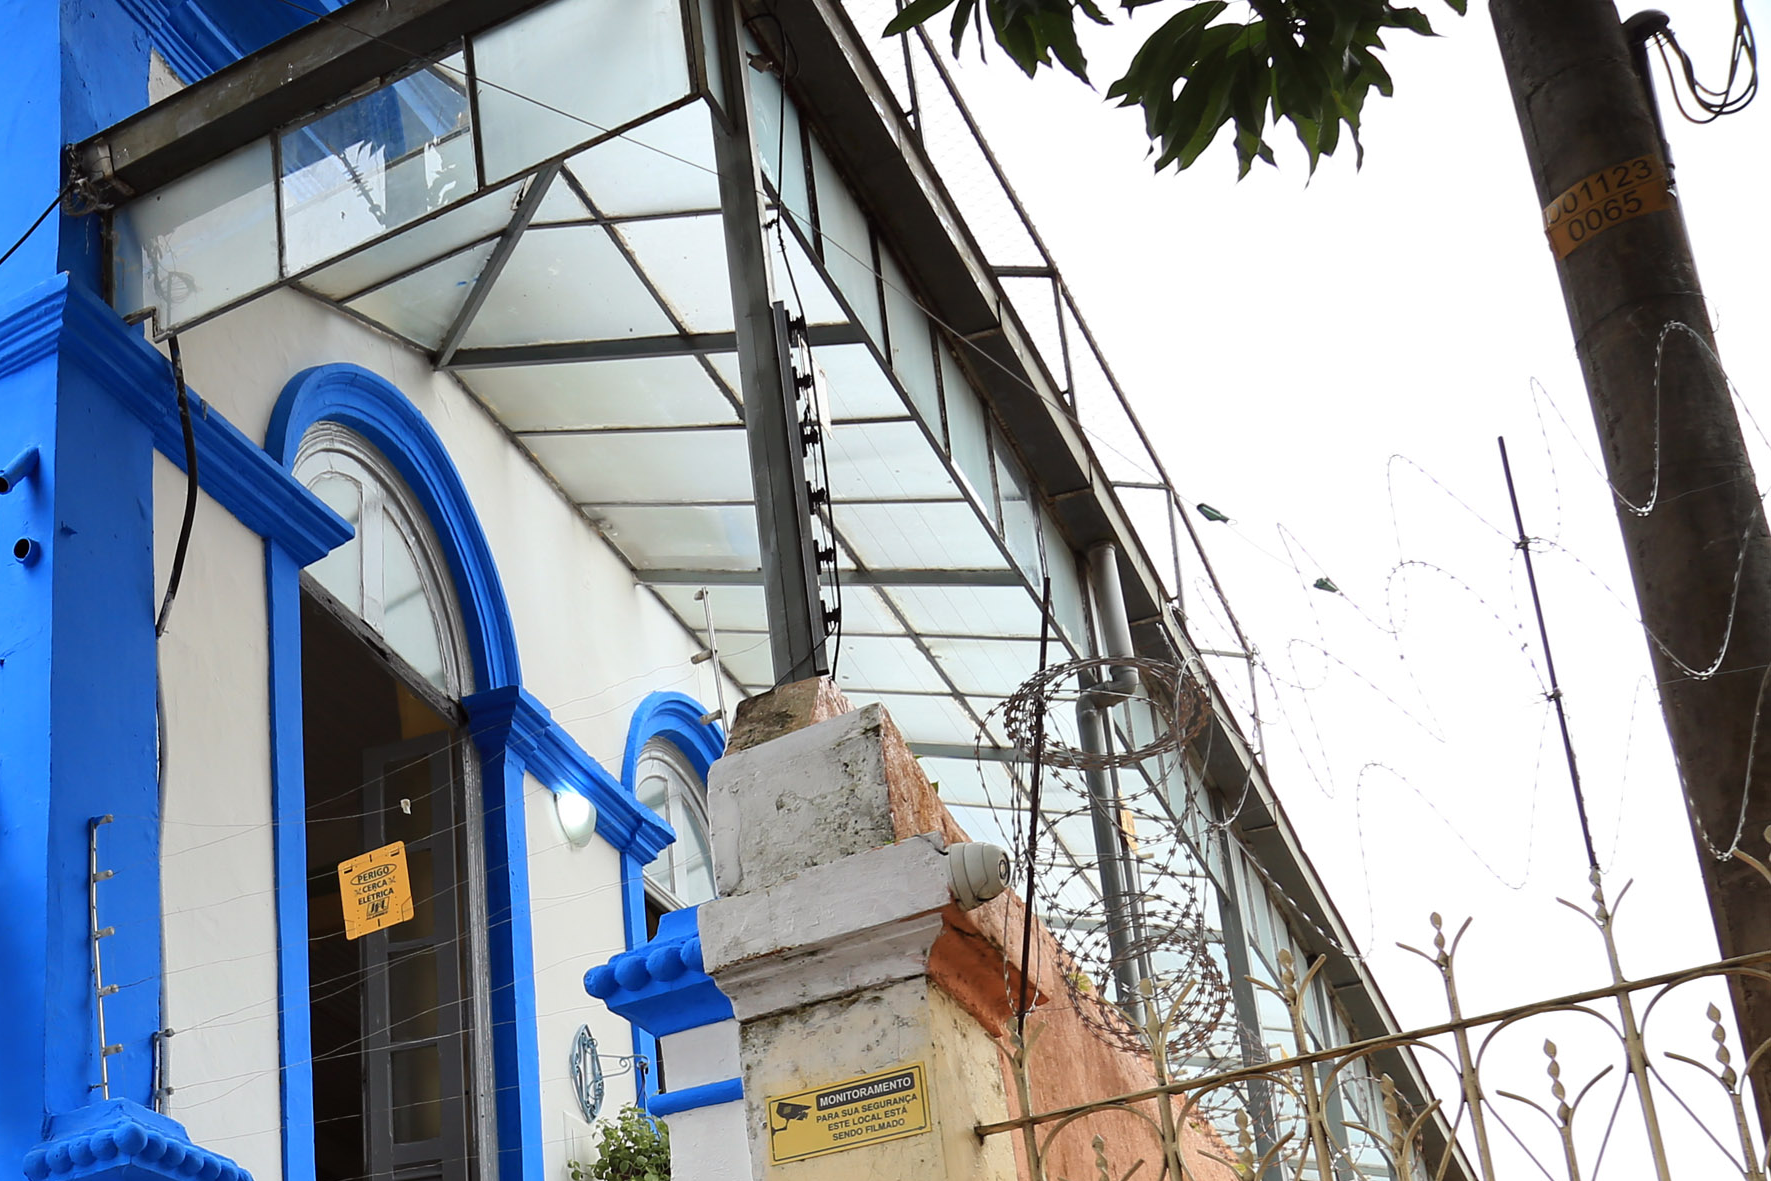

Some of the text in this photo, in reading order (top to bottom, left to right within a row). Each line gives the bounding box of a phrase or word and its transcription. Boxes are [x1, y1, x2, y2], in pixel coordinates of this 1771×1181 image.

[1569, 190, 1642, 241] 0065
[357, 865, 390, 884] PERIGO
[362, 879, 388, 894] CERCA
[819, 1076, 911, 1107] MONITORAMENTO
[816, 1093, 918, 1123] PARA SUA SEGURANÇA
[828, 1105, 908, 1132] ESTE LOCAL ESTÁ
[832, 1118, 906, 1141] SENDO FILMADO
